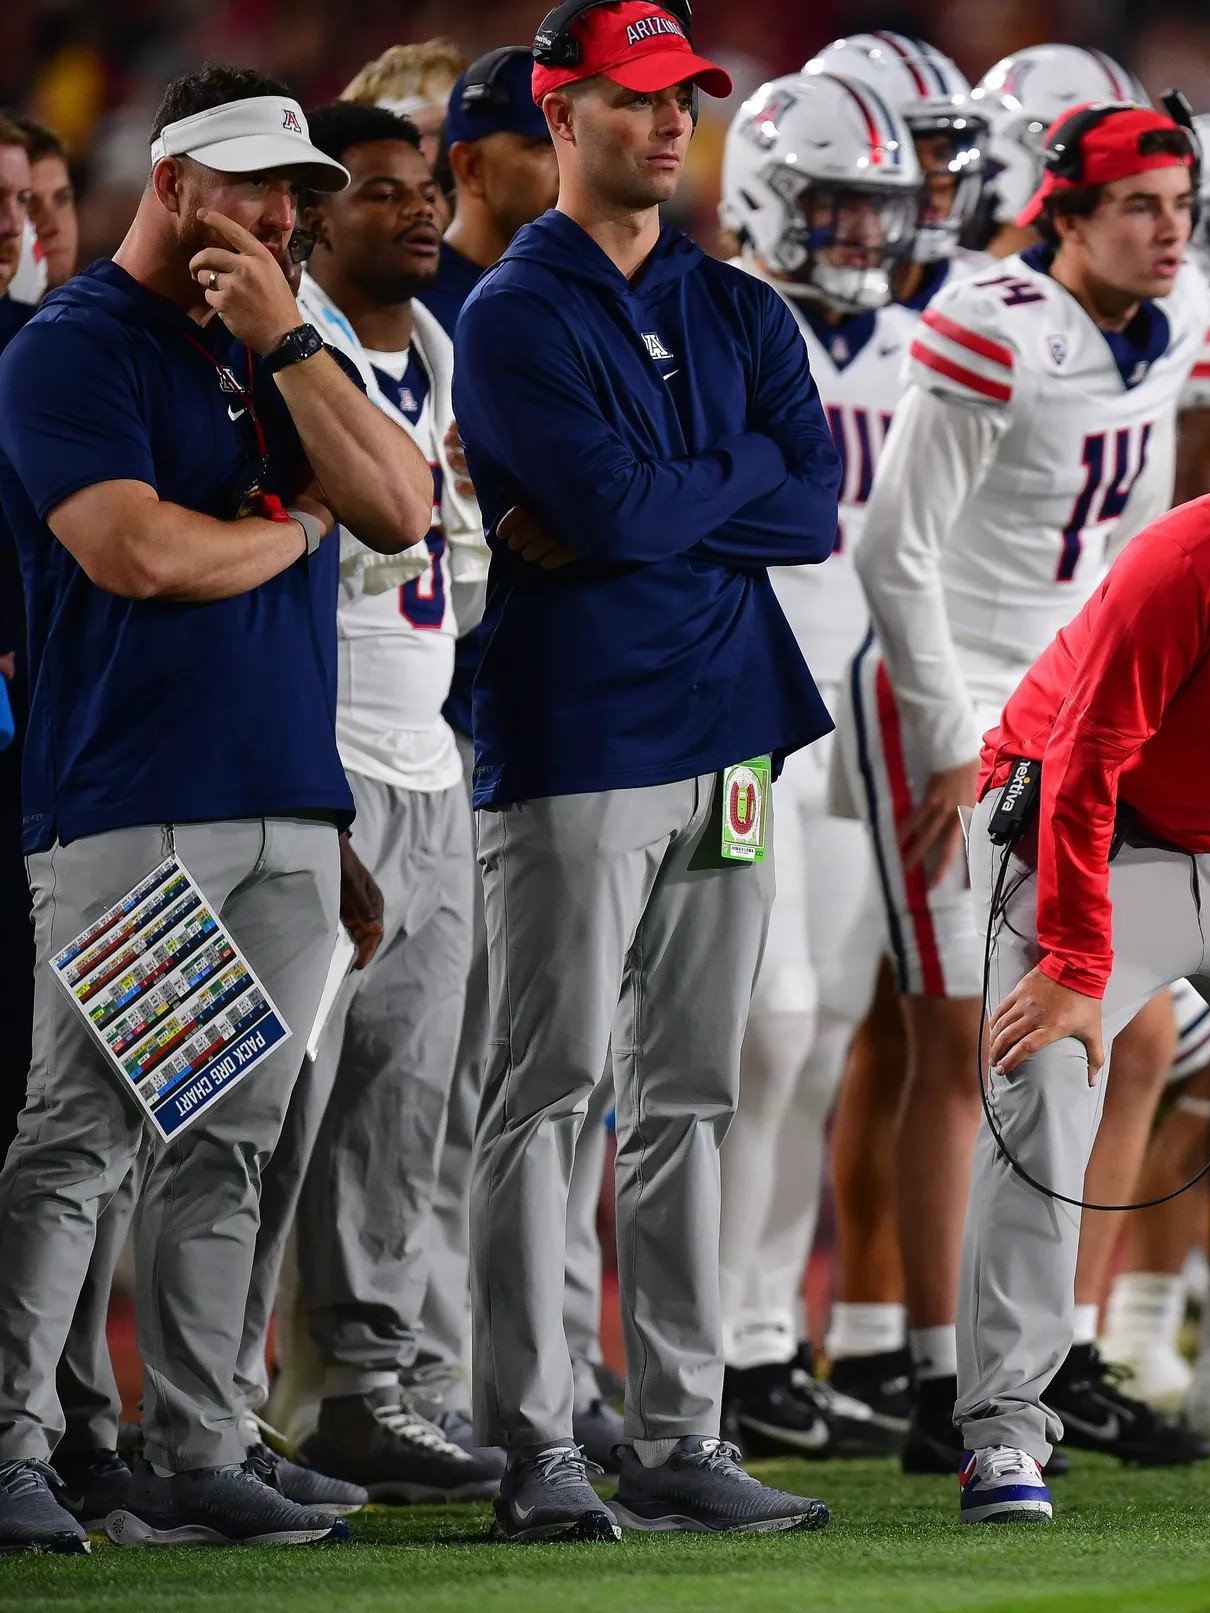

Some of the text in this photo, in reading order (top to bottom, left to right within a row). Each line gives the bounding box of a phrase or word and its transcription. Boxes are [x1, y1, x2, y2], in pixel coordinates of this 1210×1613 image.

[282, 109, 302, 133] A
[641, 332, 674, 360] A
[1055, 420, 1153, 583] 14
[175, 1030, 266, 1117] PACK ORG CHART
